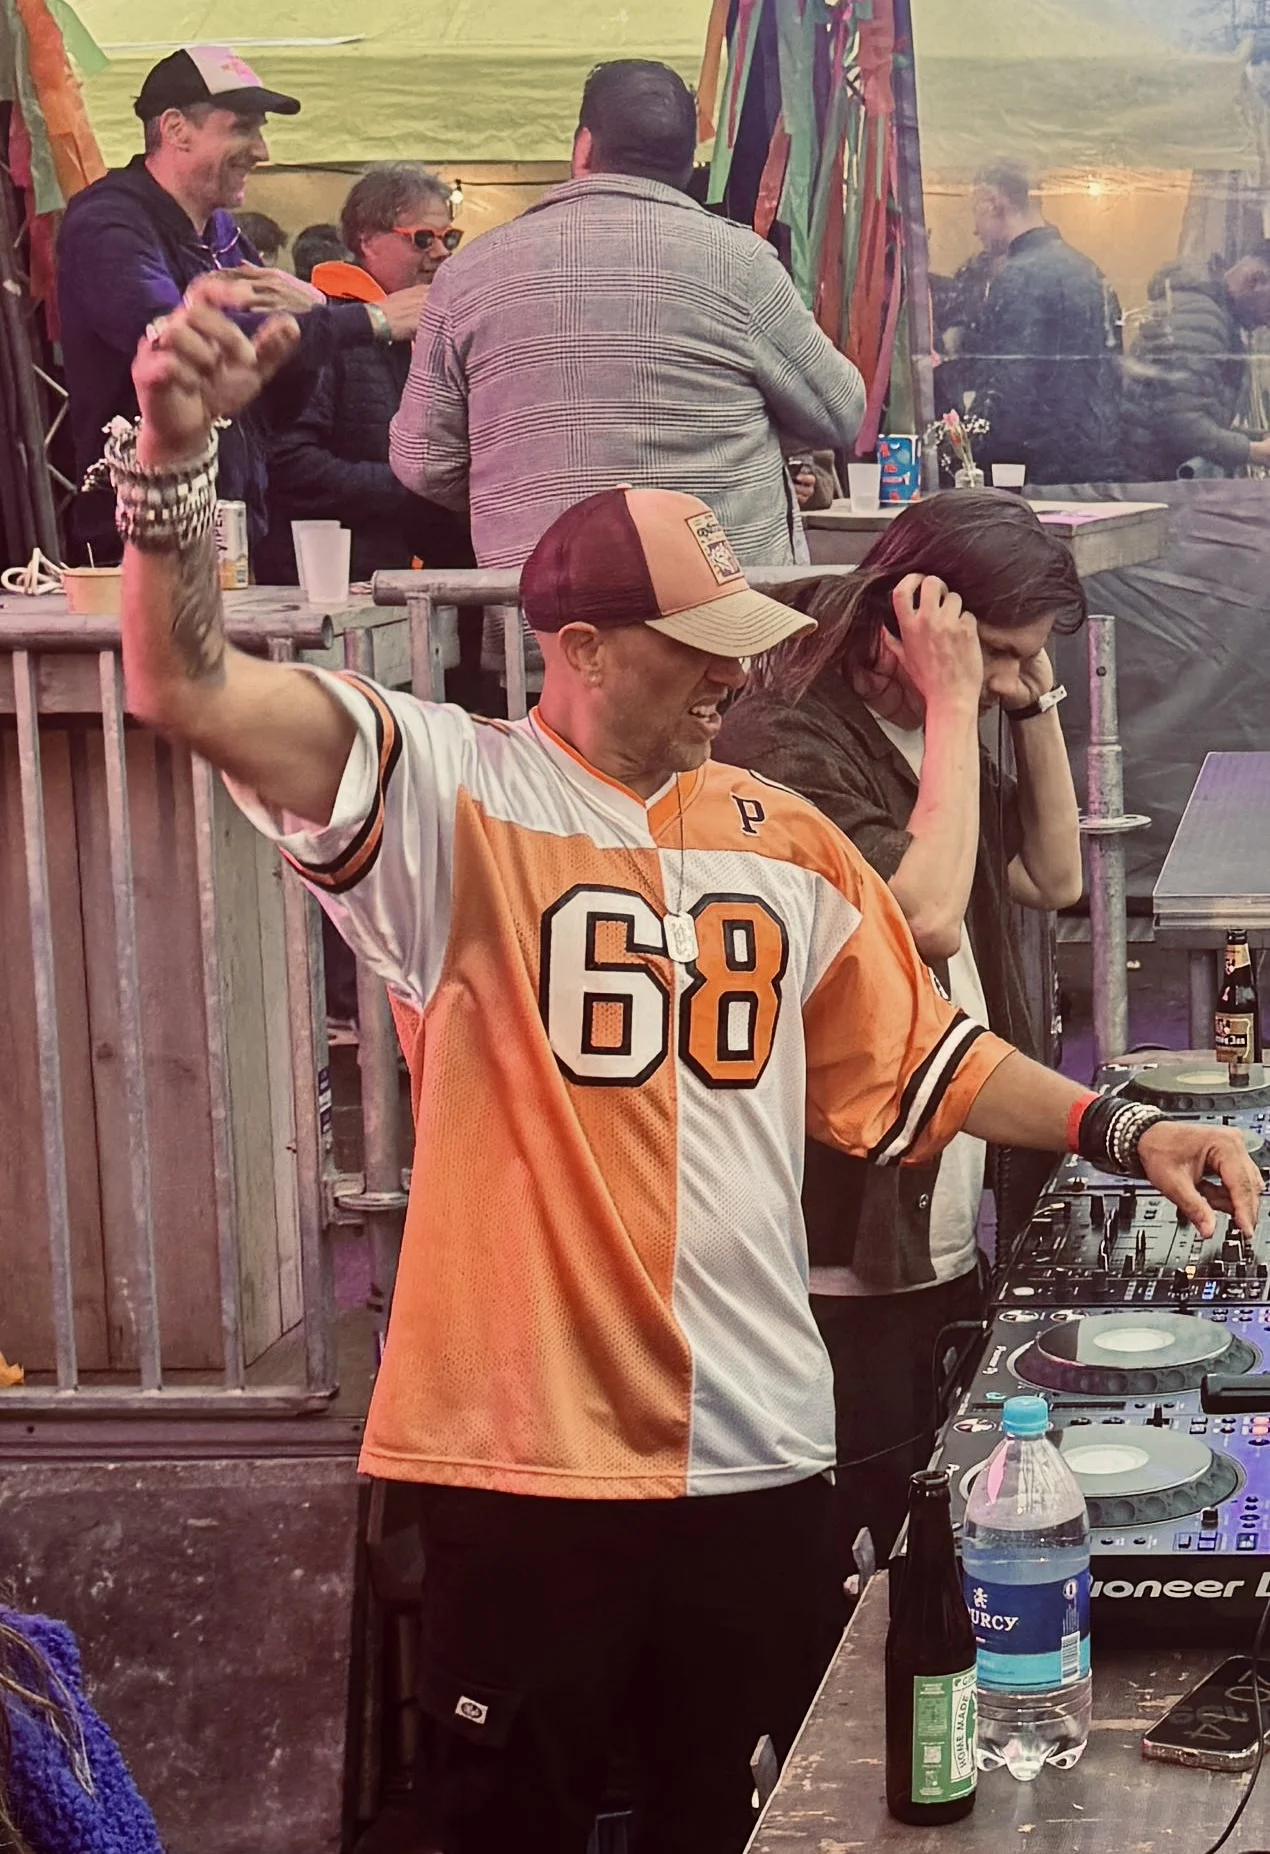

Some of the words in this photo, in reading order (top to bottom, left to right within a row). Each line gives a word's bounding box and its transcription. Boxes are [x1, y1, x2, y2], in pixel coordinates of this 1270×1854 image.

[730, 792, 766, 835] P
[540, 883, 789, 1089] 68
[1088, 1577, 1245, 1599] ioneer
[967, 1606, 1020, 1632] URCY
[957, 1695, 968, 1730] MADE
[957, 1736, 967, 1768] HOME
